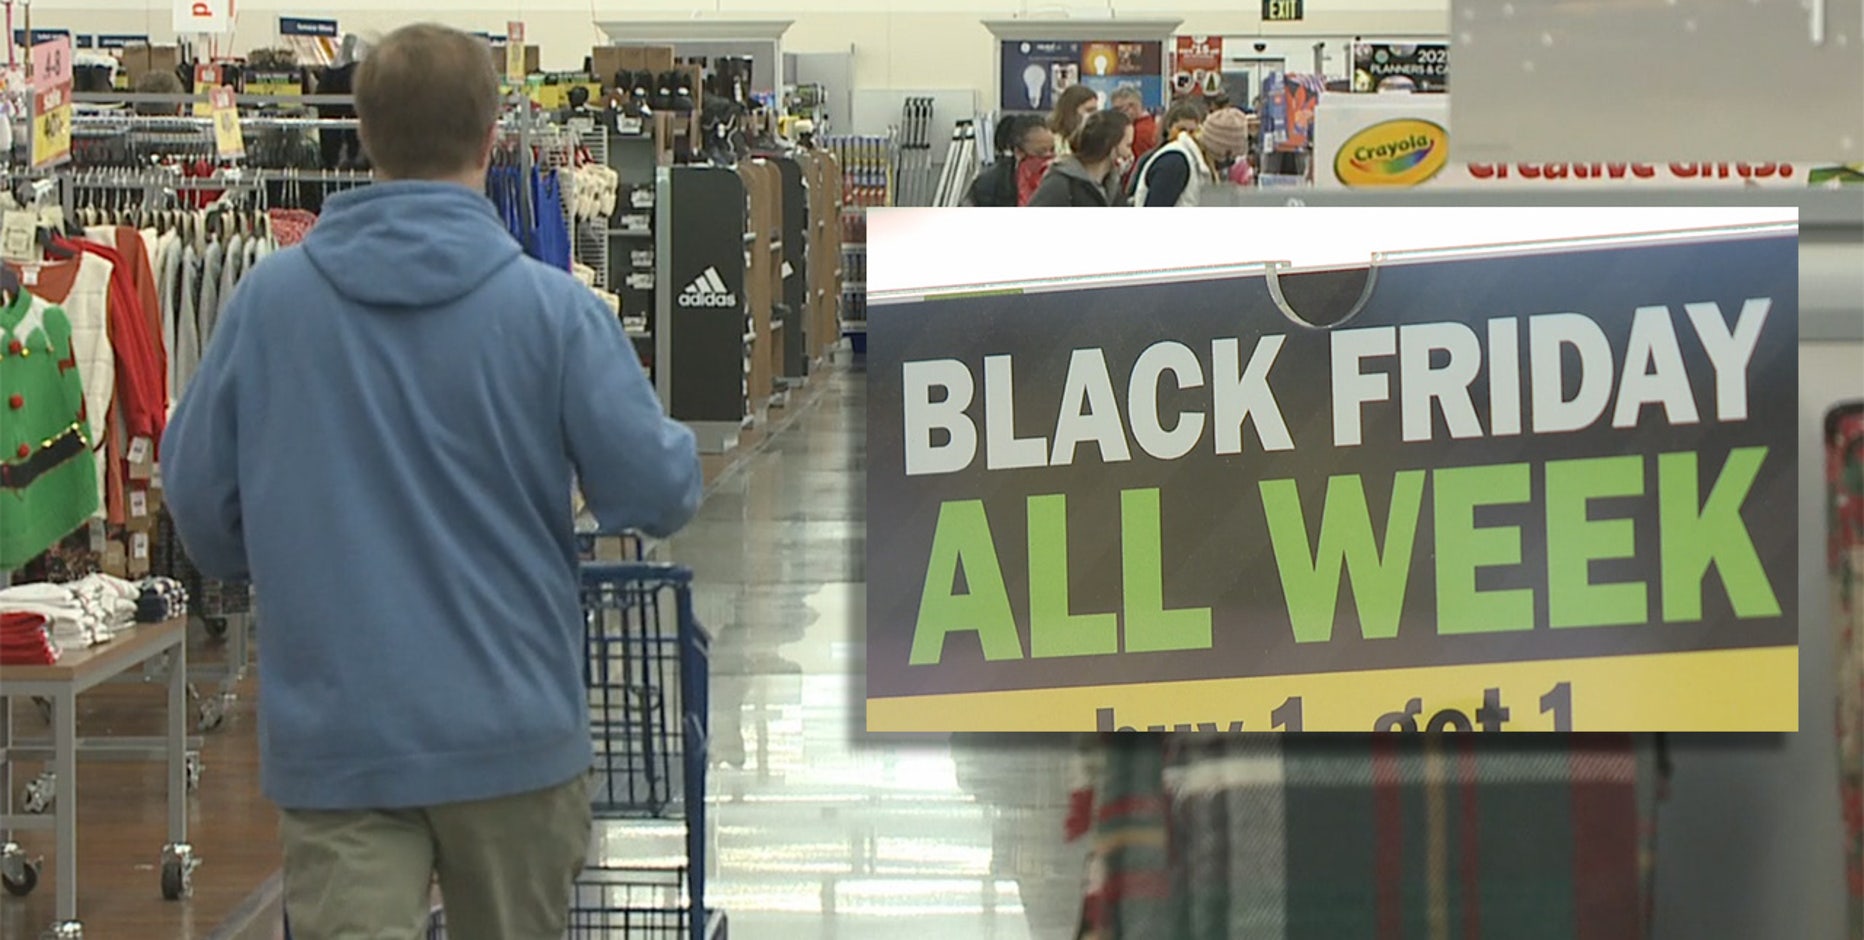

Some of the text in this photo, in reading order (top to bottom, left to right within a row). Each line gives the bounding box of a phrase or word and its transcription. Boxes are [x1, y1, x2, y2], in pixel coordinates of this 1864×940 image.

[1269, 0, 1298, 19] EXIT
[1370, 63, 1425, 75] PLANNERS
[1353, 134, 1428, 162] Crayola
[678, 292, 736, 307] adidas
[902, 297, 1773, 476] BLACK FRIDAY
[908, 446, 1783, 667] ALL WEEK
